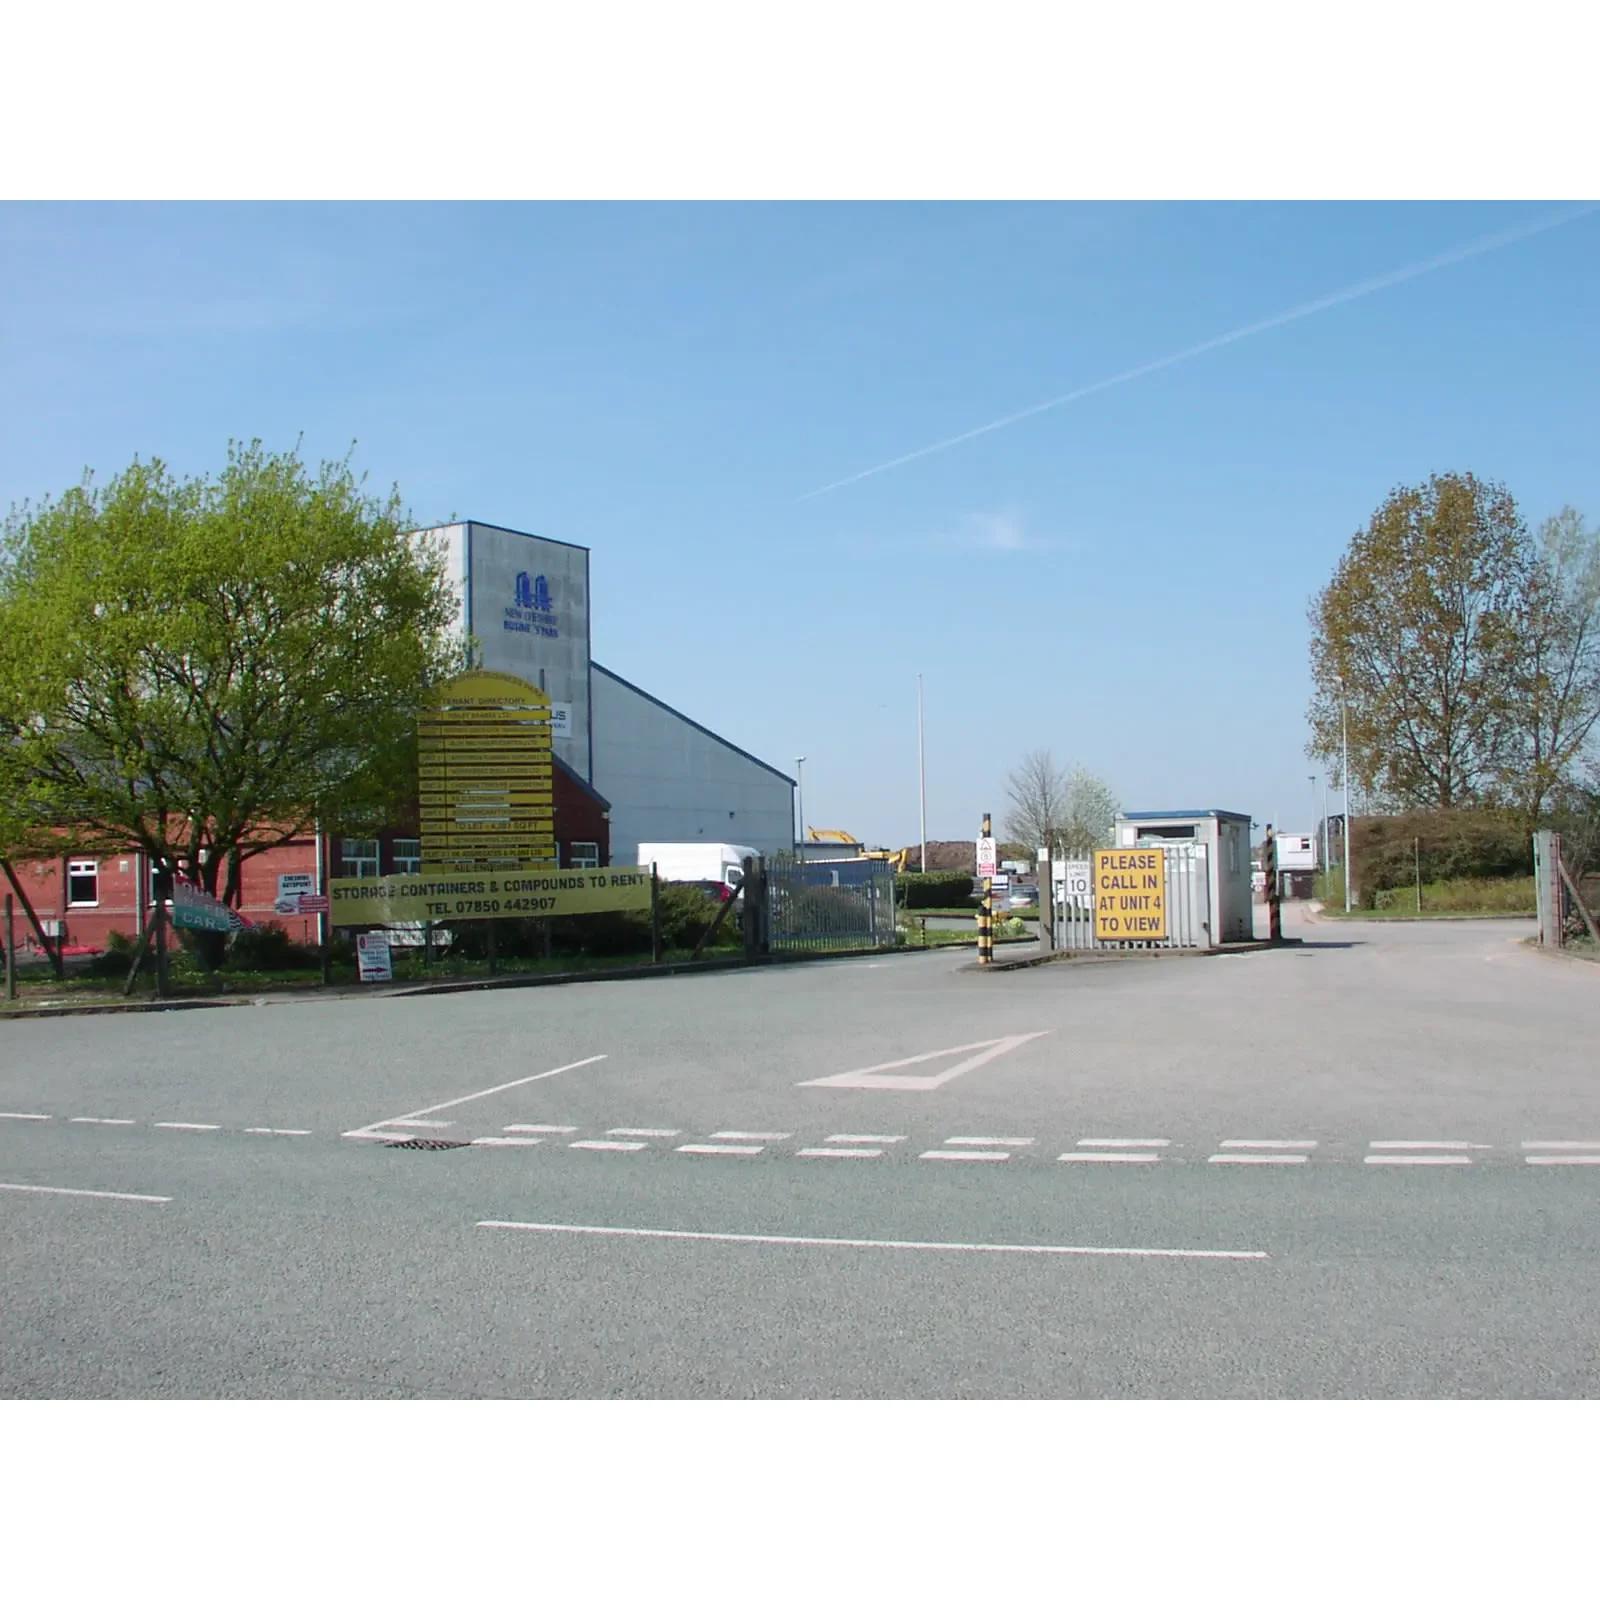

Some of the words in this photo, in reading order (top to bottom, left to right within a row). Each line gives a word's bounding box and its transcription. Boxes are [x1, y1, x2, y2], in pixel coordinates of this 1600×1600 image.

[1101, 855, 1156, 870] PLEASE
[333, 885, 396, 900] STORAGE
[400, 880, 485, 897] CONTAINERS
[490, 880, 499, 893] &
[503, 876, 585, 893] COMPOUNDS
[588, 875, 606, 889] TO
[610, 872, 645, 887] RENT
[1071, 879, 1087, 892] 10
[1101, 875, 1138, 889] CALL
[1142, 875, 1157, 888] IN
[426, 901, 451, 915] TEL
[455, 900, 499, 913] 07850
[503, 897, 556, 912] 442907
[1100, 896, 1116, 910] AT
[1120, 896, 1152, 910] UNIT
[1153, 895, 1161, 909] 4
[1101, 917, 1120, 931] TO
[1124, 917, 1160, 931] VIEW
